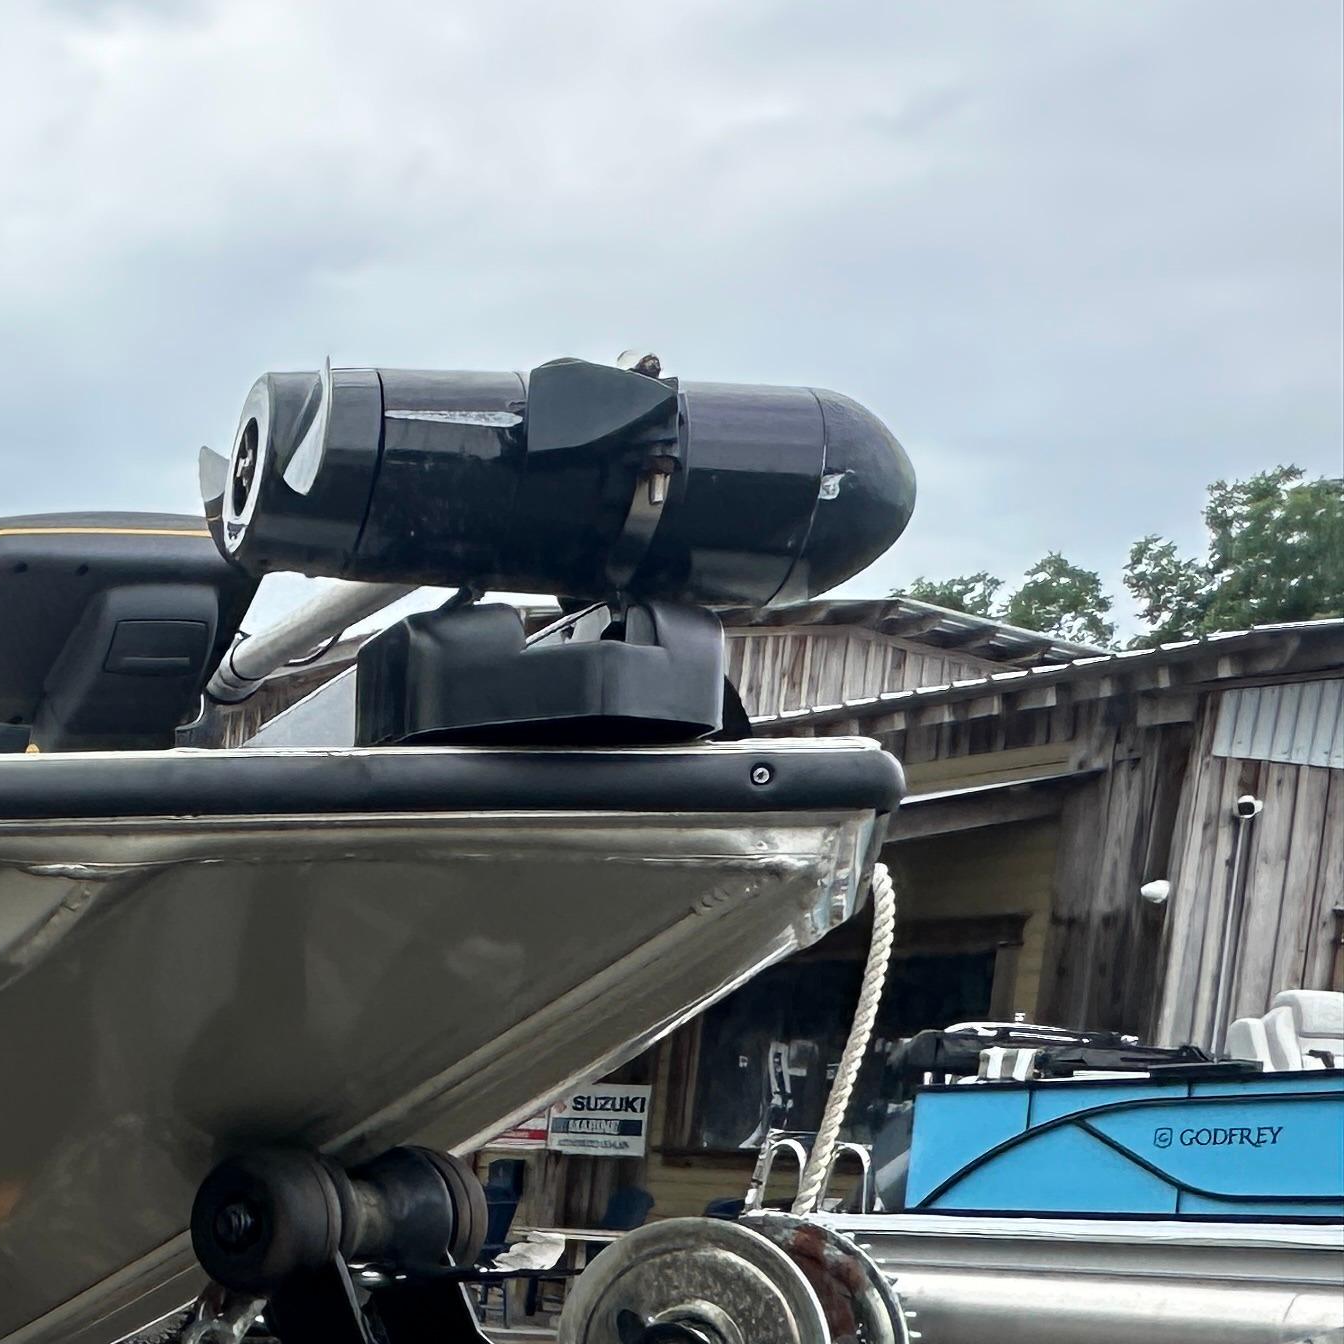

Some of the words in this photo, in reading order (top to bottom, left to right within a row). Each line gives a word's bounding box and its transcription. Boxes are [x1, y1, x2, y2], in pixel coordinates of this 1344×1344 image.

[572, 1095, 647, 1114] SUZUKI
[568, 1119, 622, 1135] MARINE
[1179, 1126, 1284, 1148] GODFREY
